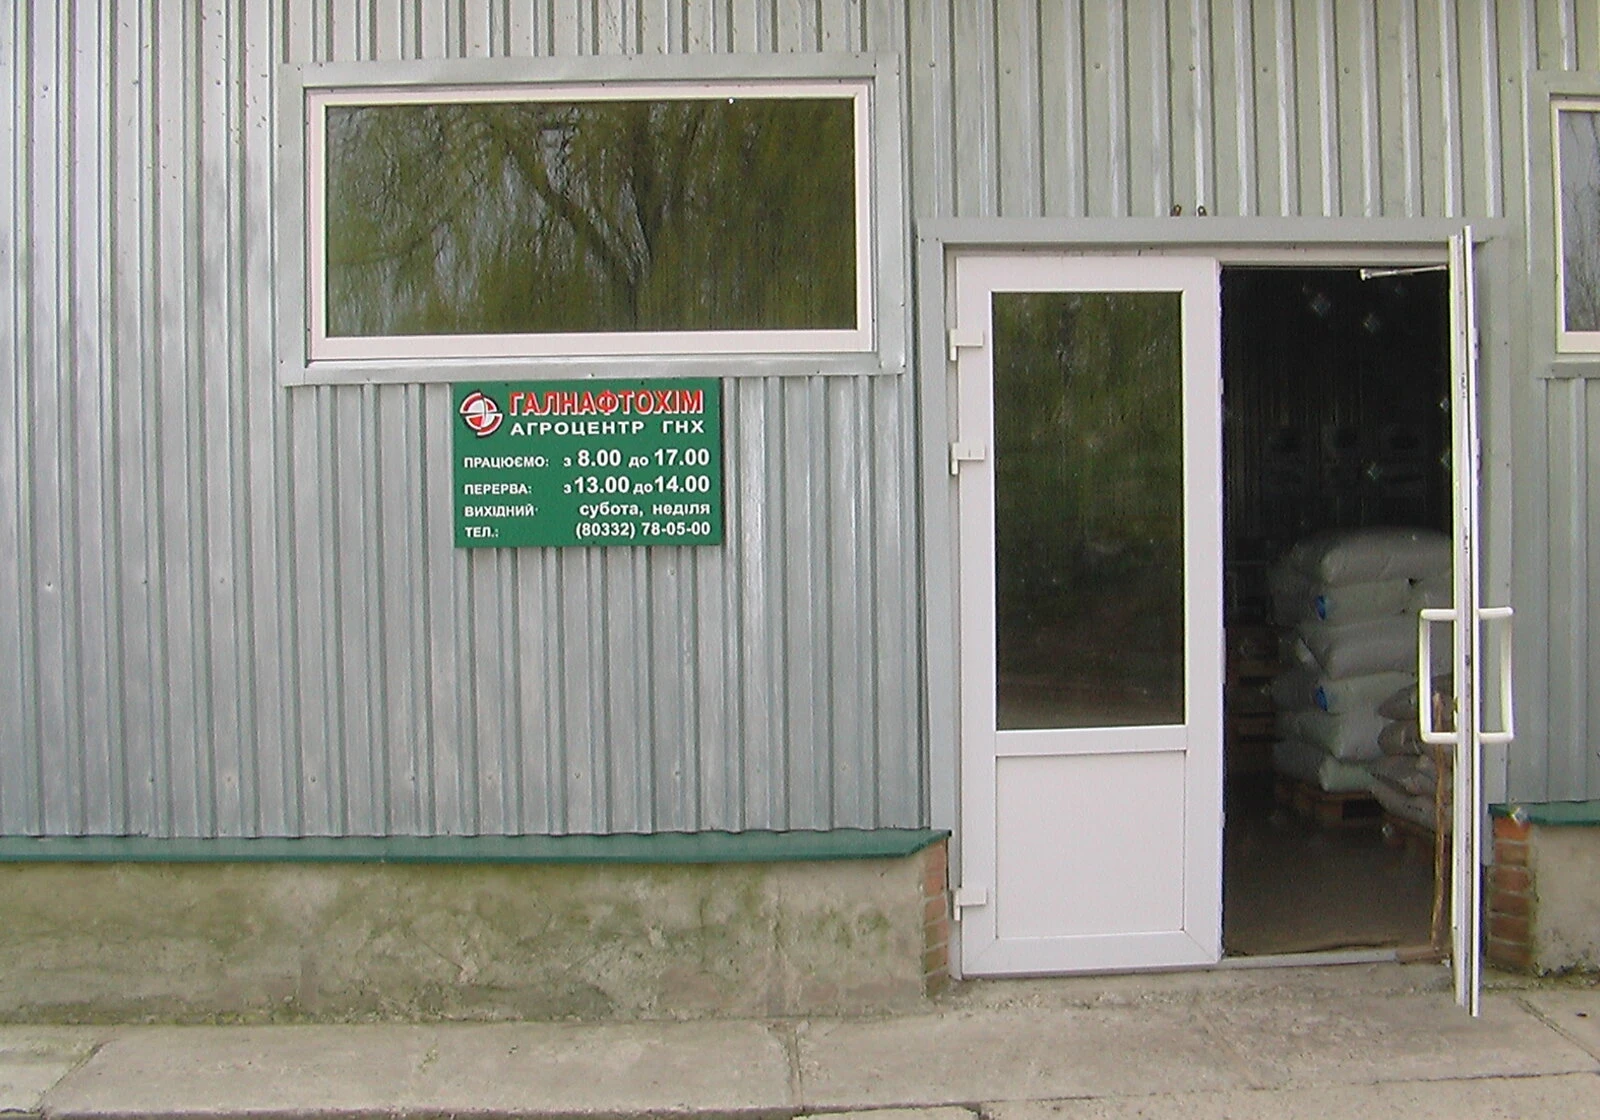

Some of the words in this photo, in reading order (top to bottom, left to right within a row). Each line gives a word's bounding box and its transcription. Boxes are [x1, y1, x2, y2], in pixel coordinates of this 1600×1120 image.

[508, 389, 704, 416] ГАЛНАФТОХІМ
[510, 421, 645, 436] АГРОЦЕНТР
[662, 420, 705, 434] ГНХ
[464, 457, 549, 469] ПРАЦЮЄМО:
[563, 457, 572, 467] з
[577, 449, 622, 467] 8.00
[629, 456, 649, 468] до
[654, 449, 710, 466] 17.00
[464, 483, 532, 495] ПЕРЕРВА:
[574, 476, 630, 494] 13.00
[633, 483, 654, 495] до
[655, 476, 710, 493] 14.00
[579, 502, 644, 518] субота,
[652, 503, 711, 516] неділя
[575, 523, 636, 540] (80332)
[641, 522, 711, 536] 78-05-00
